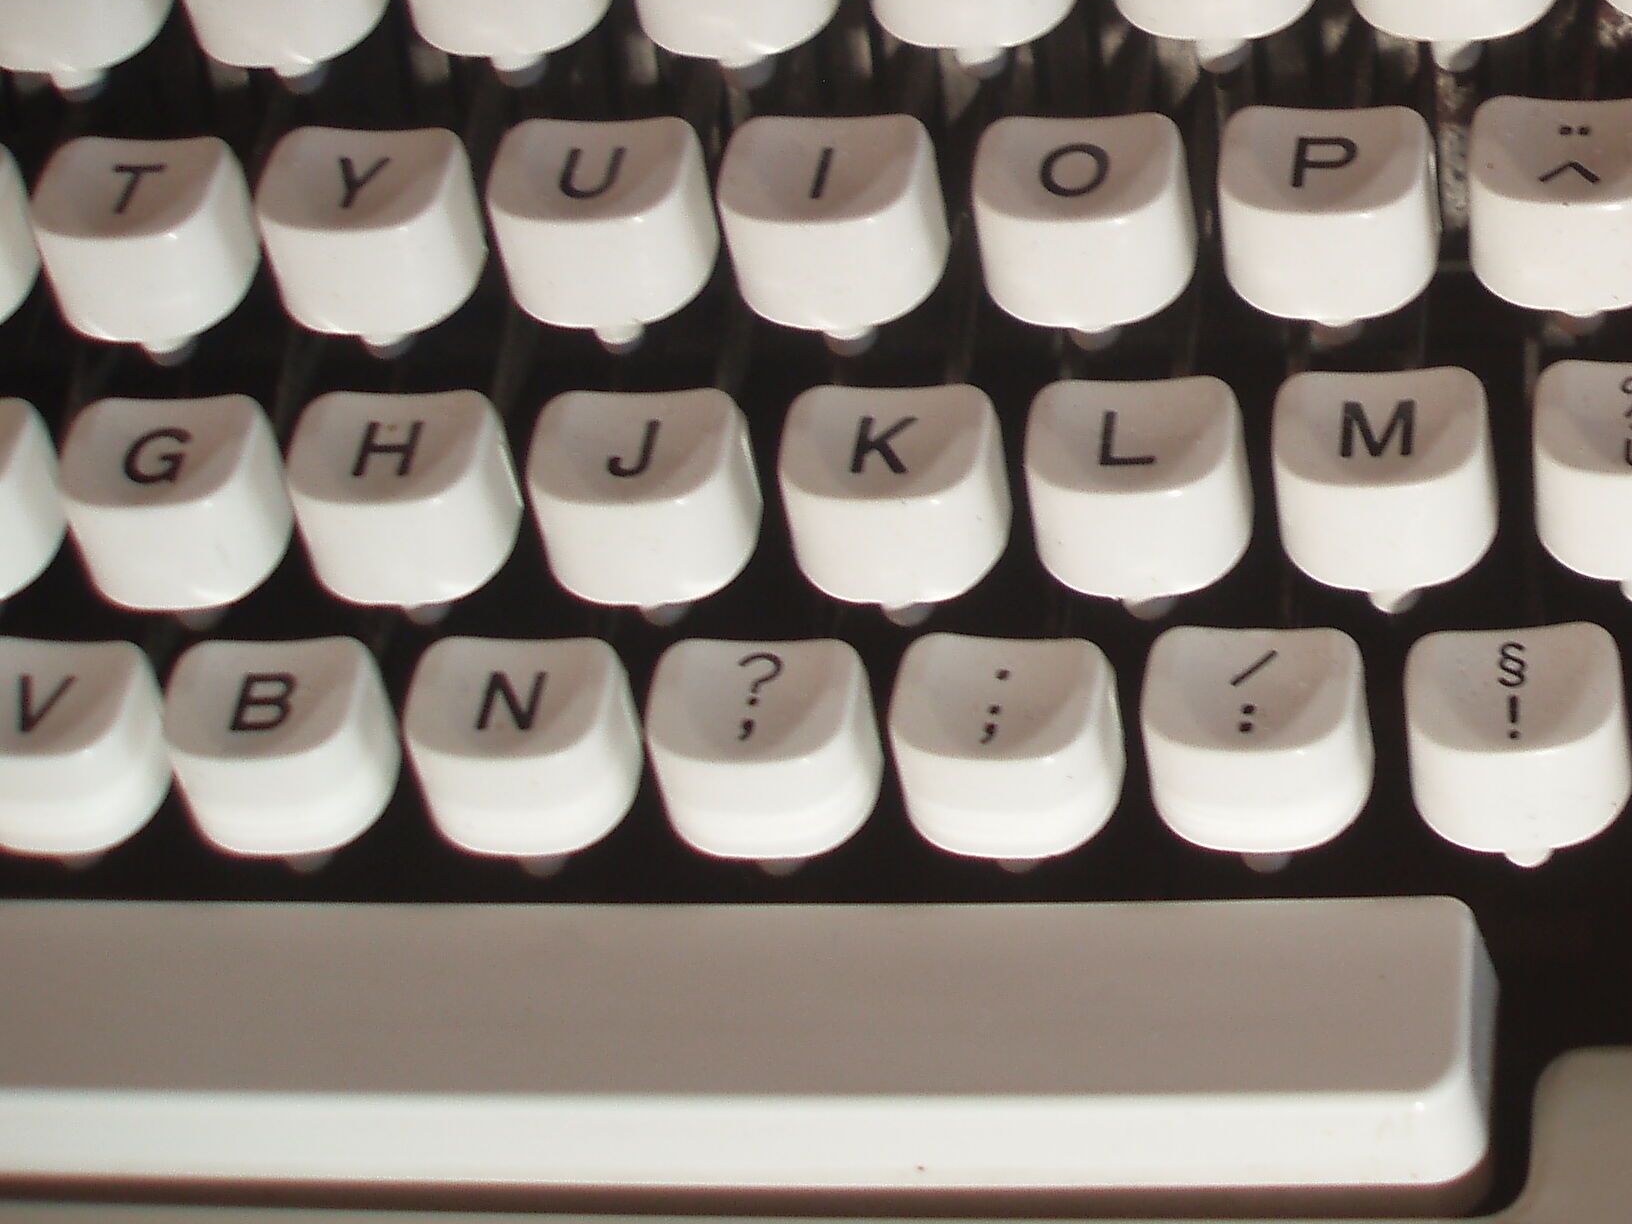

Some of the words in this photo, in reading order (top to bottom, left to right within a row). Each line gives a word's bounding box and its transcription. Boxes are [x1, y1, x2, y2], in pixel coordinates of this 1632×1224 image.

[338, 156, 390, 209] Y
[559, 148, 625, 199] U
[809, 147, 834, 200] I
[1039, 144, 1109, 198] O
[1291, 136, 1358, 188] P
[114, 165, 166, 214] T
[123, 428, 192, 484] G
[352, 422, 425, 477] H
[607, 421, 659, 478] J
[849, 416, 918, 475] K
[1098, 411, 1156, 466] L
[1338, 400, 1416, 458] M
[737, 653, 782, 705] ?
[1230, 649, 1278, 687] /
[1497, 642, 1527, 687] §
[18, 674, 75, 733] V
[230, 674, 295, 731] B
[476, 671, 546, 731] N
[1508, 695, 1520, 739] !
